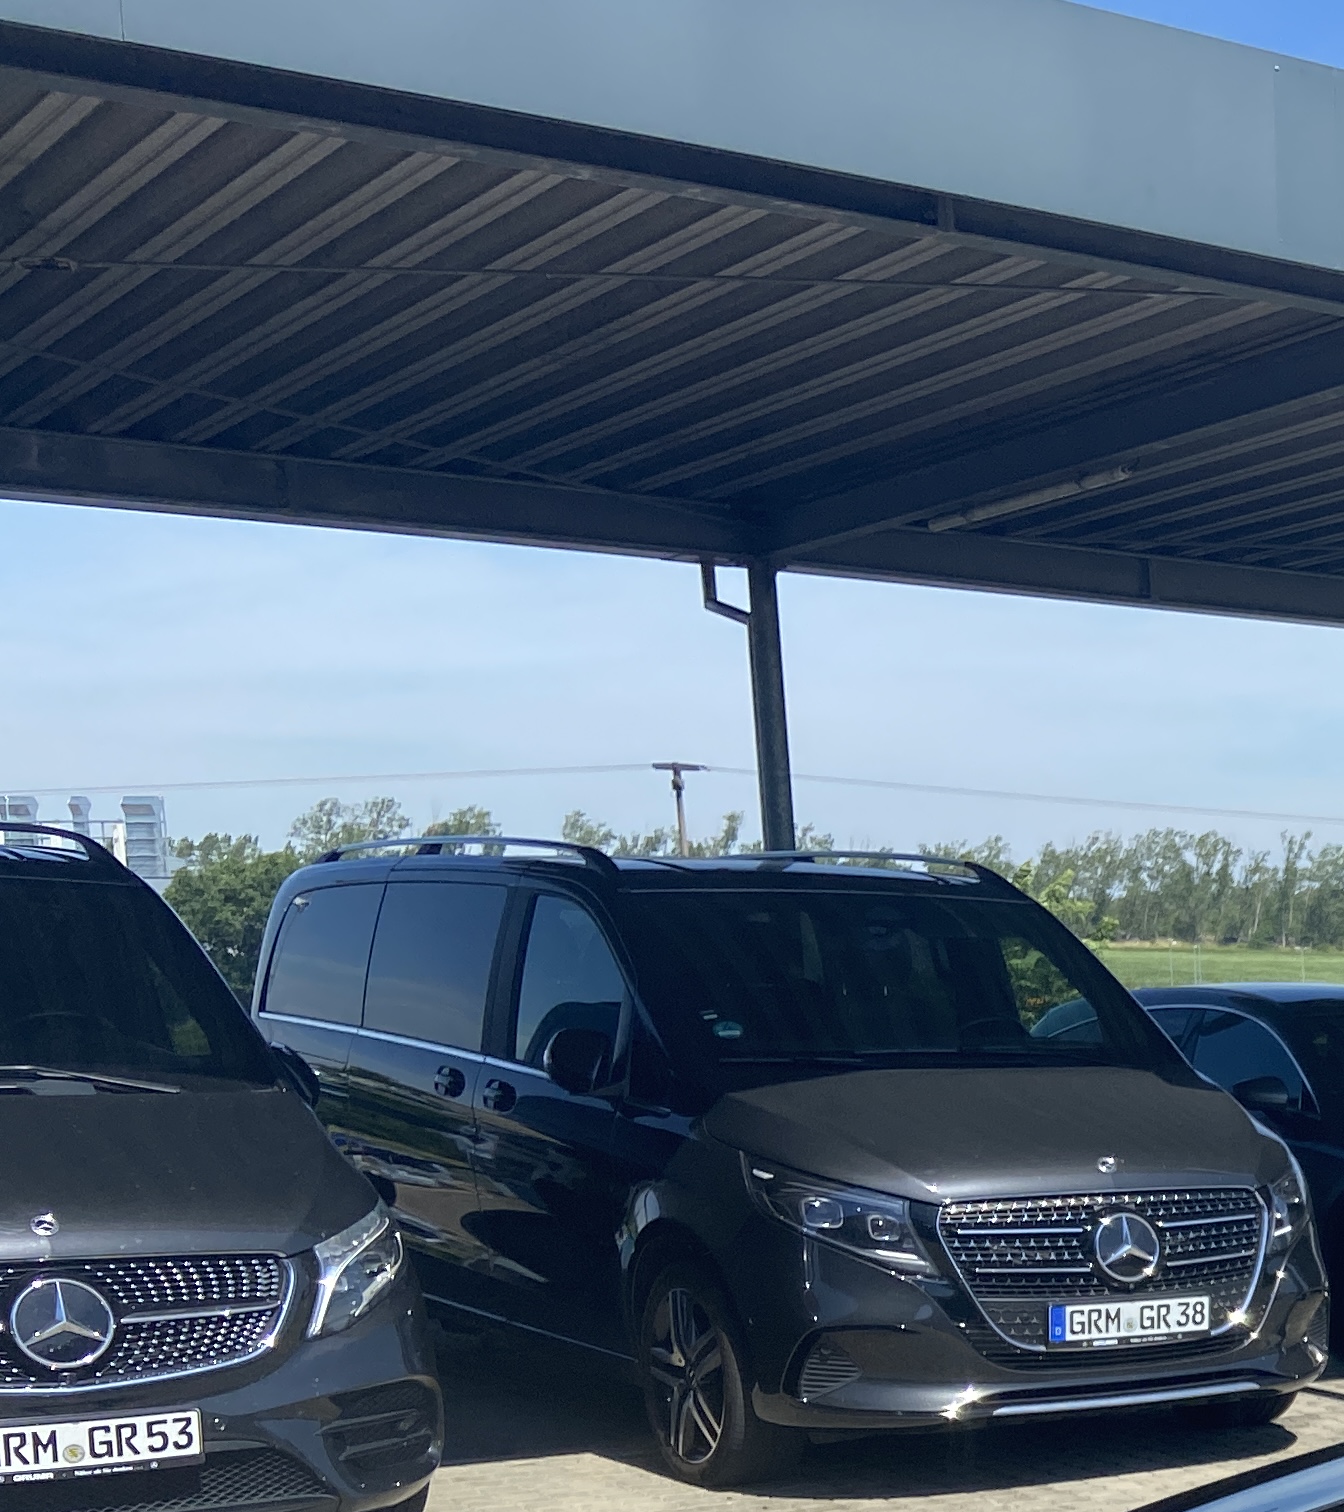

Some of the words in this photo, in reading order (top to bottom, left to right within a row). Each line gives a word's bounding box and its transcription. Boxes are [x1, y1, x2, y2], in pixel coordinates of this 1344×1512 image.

[1069, 1307, 1121, 1335] GRM
[1139, 1303, 1171, 1331] GR
[1176, 1301, 1206, 1328] 38
[0, 1429, 59, 1467] RM
[87, 1422, 141, 1459] GR
[146, 1416, 194, 1453] 53
